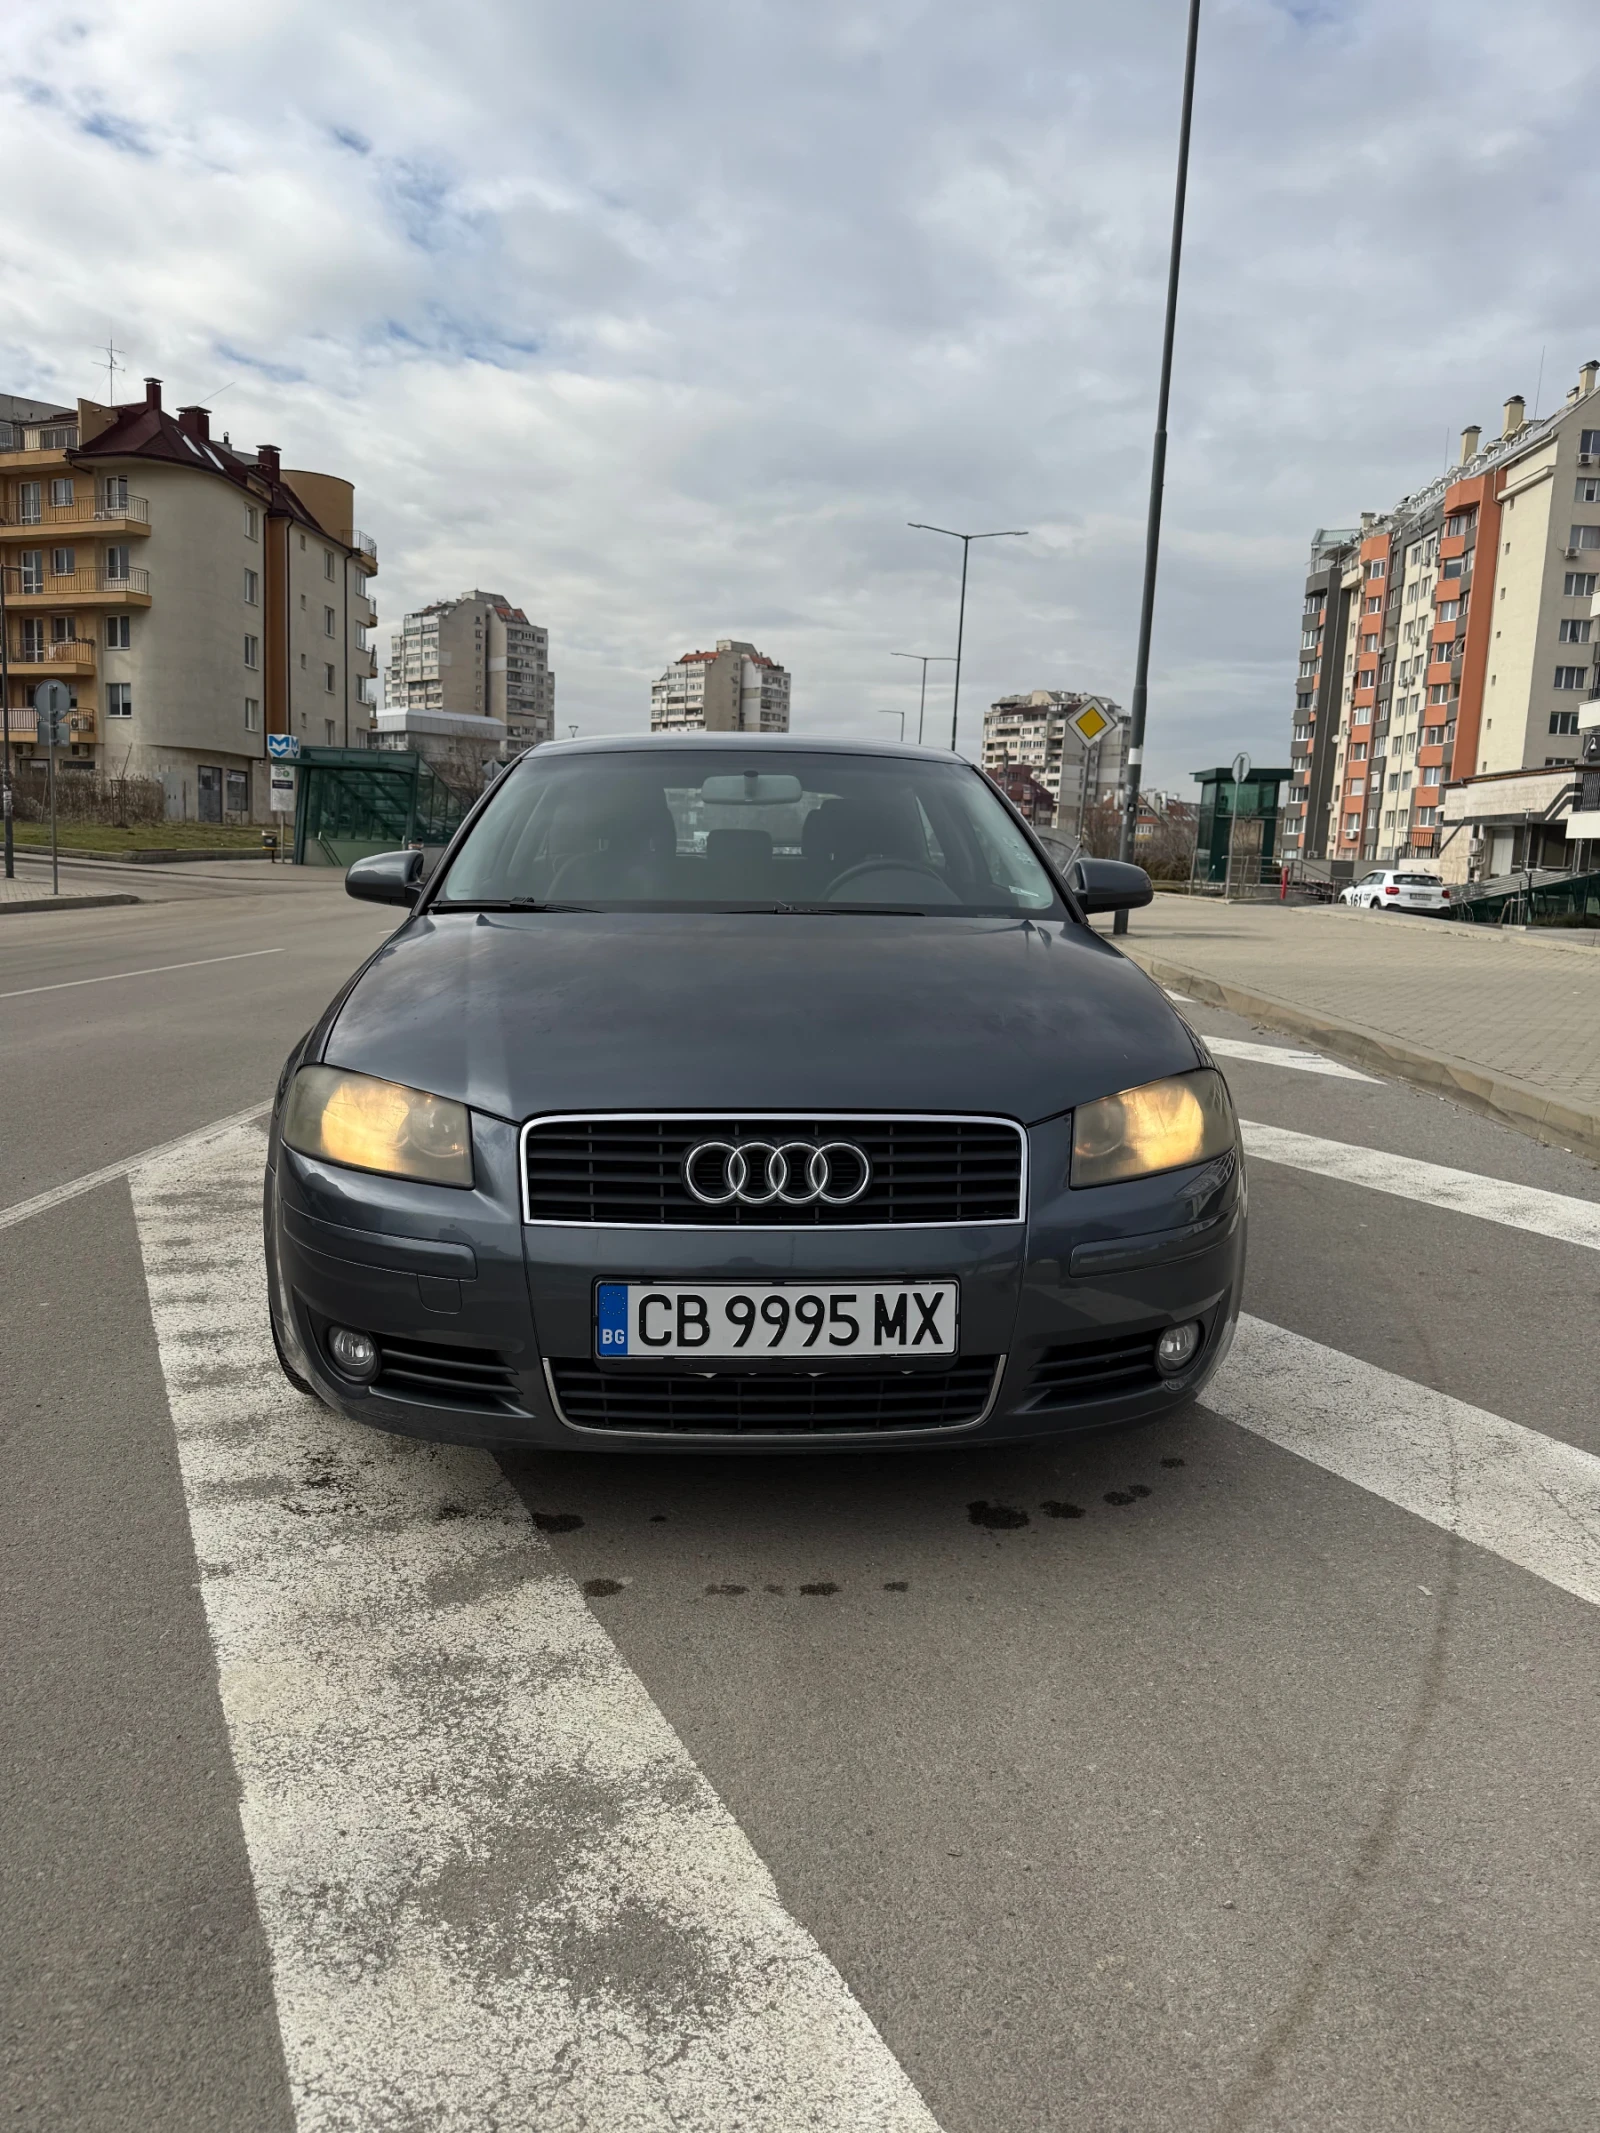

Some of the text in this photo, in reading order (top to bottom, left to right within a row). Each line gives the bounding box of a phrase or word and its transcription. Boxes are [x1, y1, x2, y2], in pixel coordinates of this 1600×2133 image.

[1350, 893, 1363, 907] 161
[638, 1291, 945, 1347] CB 9995 MX
[602, 1328, 625, 1345] BG
